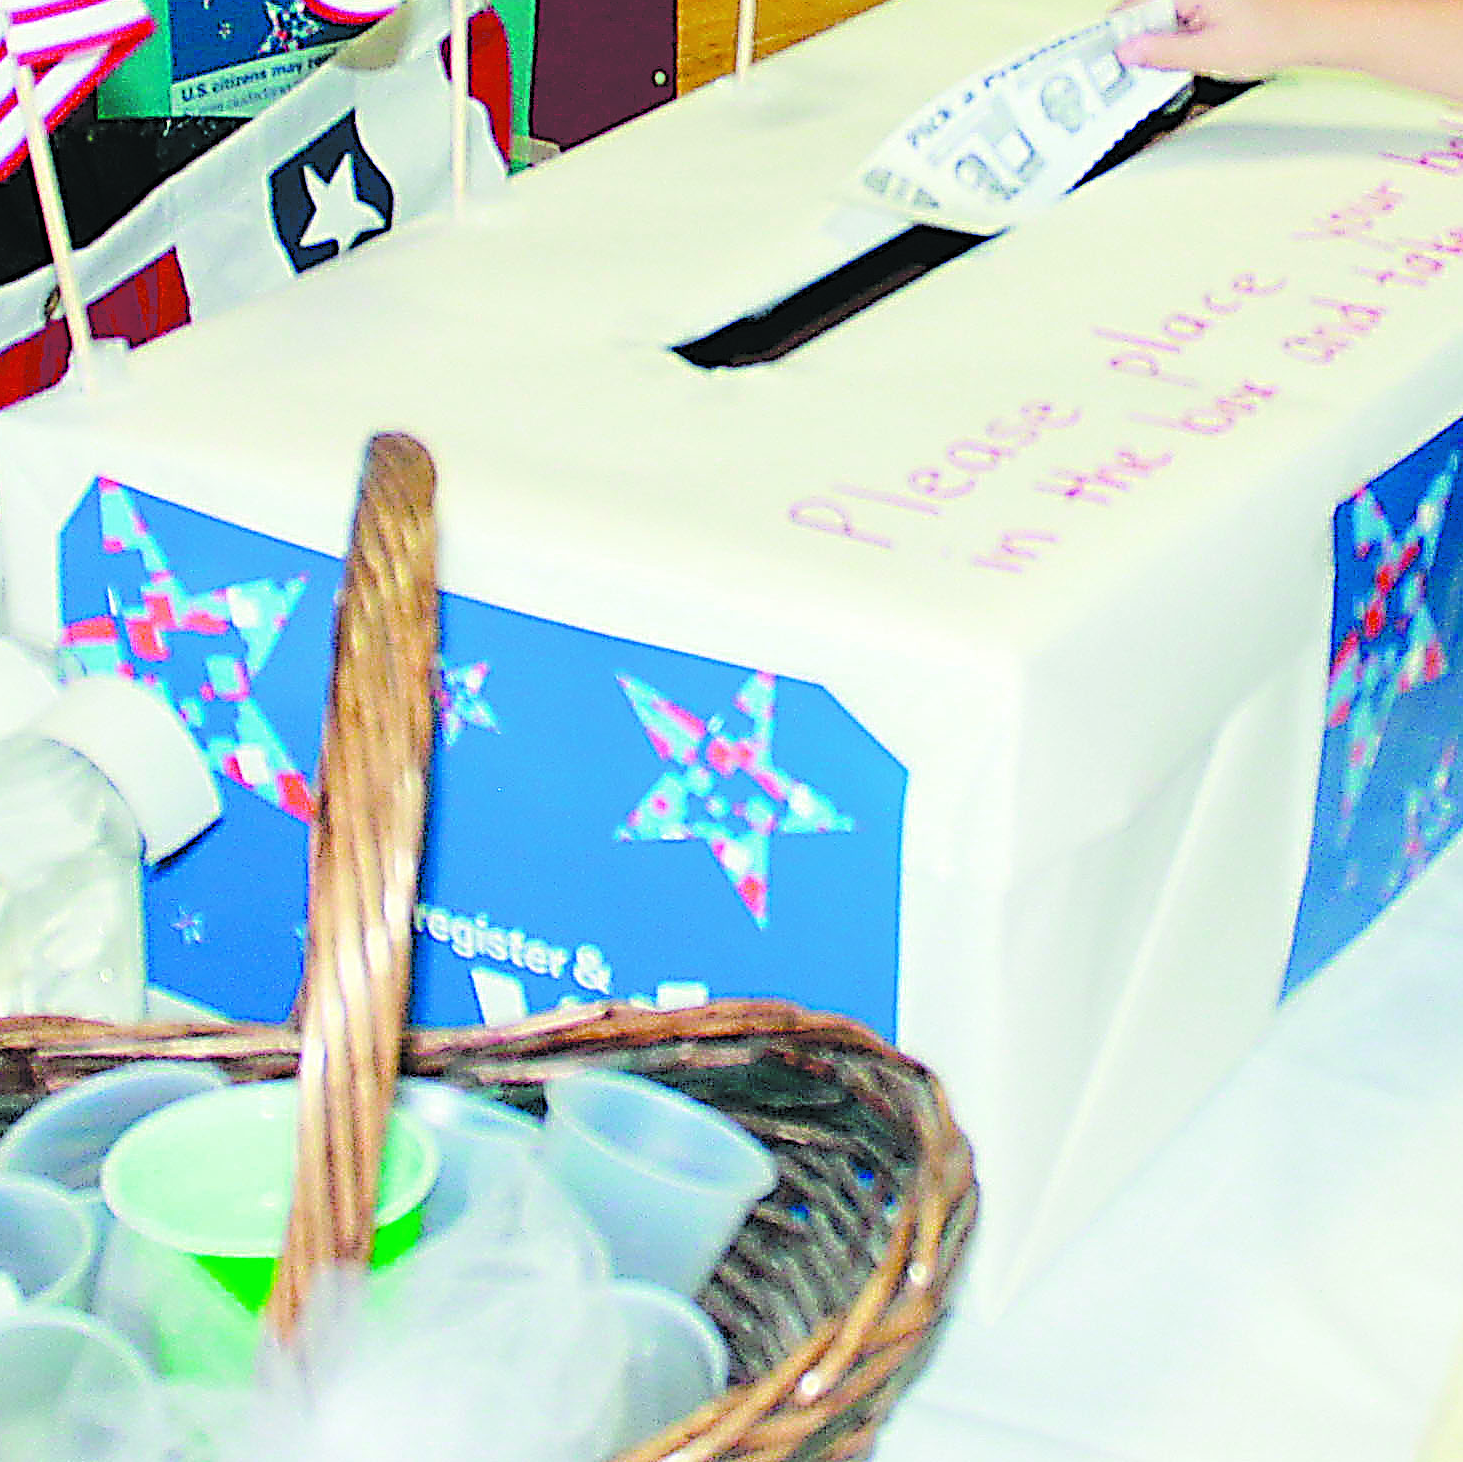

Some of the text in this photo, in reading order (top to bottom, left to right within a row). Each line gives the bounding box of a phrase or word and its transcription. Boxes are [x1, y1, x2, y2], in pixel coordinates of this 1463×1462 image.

[788, 398, 1084, 550] Please
[1091, 272, 1290, 389] place
[968, 530, 1080, 575] in
[1031, 449, 1174, 506] the
[414, 900, 612, 996] register &
